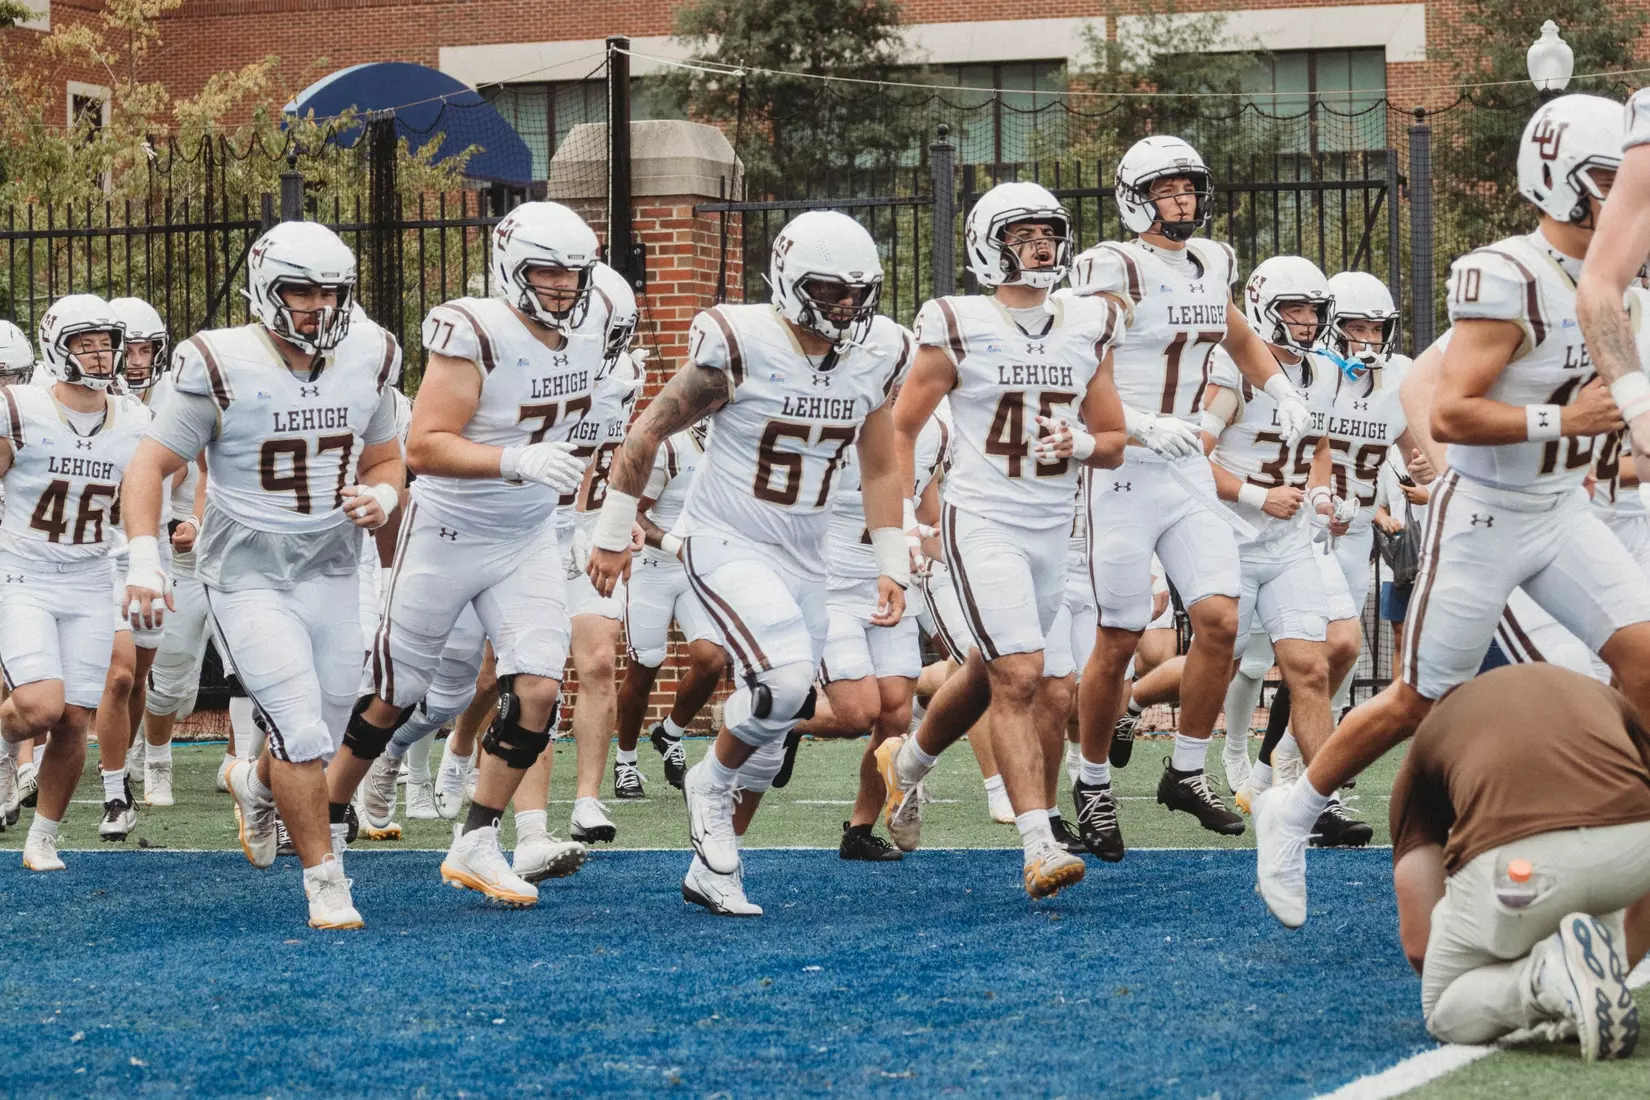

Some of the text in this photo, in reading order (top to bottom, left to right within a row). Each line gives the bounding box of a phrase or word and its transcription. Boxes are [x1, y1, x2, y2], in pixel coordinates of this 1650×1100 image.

[1076, 257, 1093, 286] 17
[1455, 267, 1481, 304] 10
[1167, 305, 1226, 325] LEHIGH
[429, 317, 455, 350] 77
[531, 370, 588, 398] LEHIGH
[998, 365, 1073, 387] LEHIGH
[1160, 331, 1226, 414] 17
[273, 407, 349, 432] LEHIGH
[518, 393, 592, 452] 77
[781, 396, 855, 420] LEHIGH
[984, 390, 1078, 478] 45
[1329, 416, 1387, 440] LEHIGH
[48, 456, 114, 480] LEHIGH
[260, 432, 354, 515] 97
[753, 420, 857, 508] 67
[29, 479, 116, 545] 46
